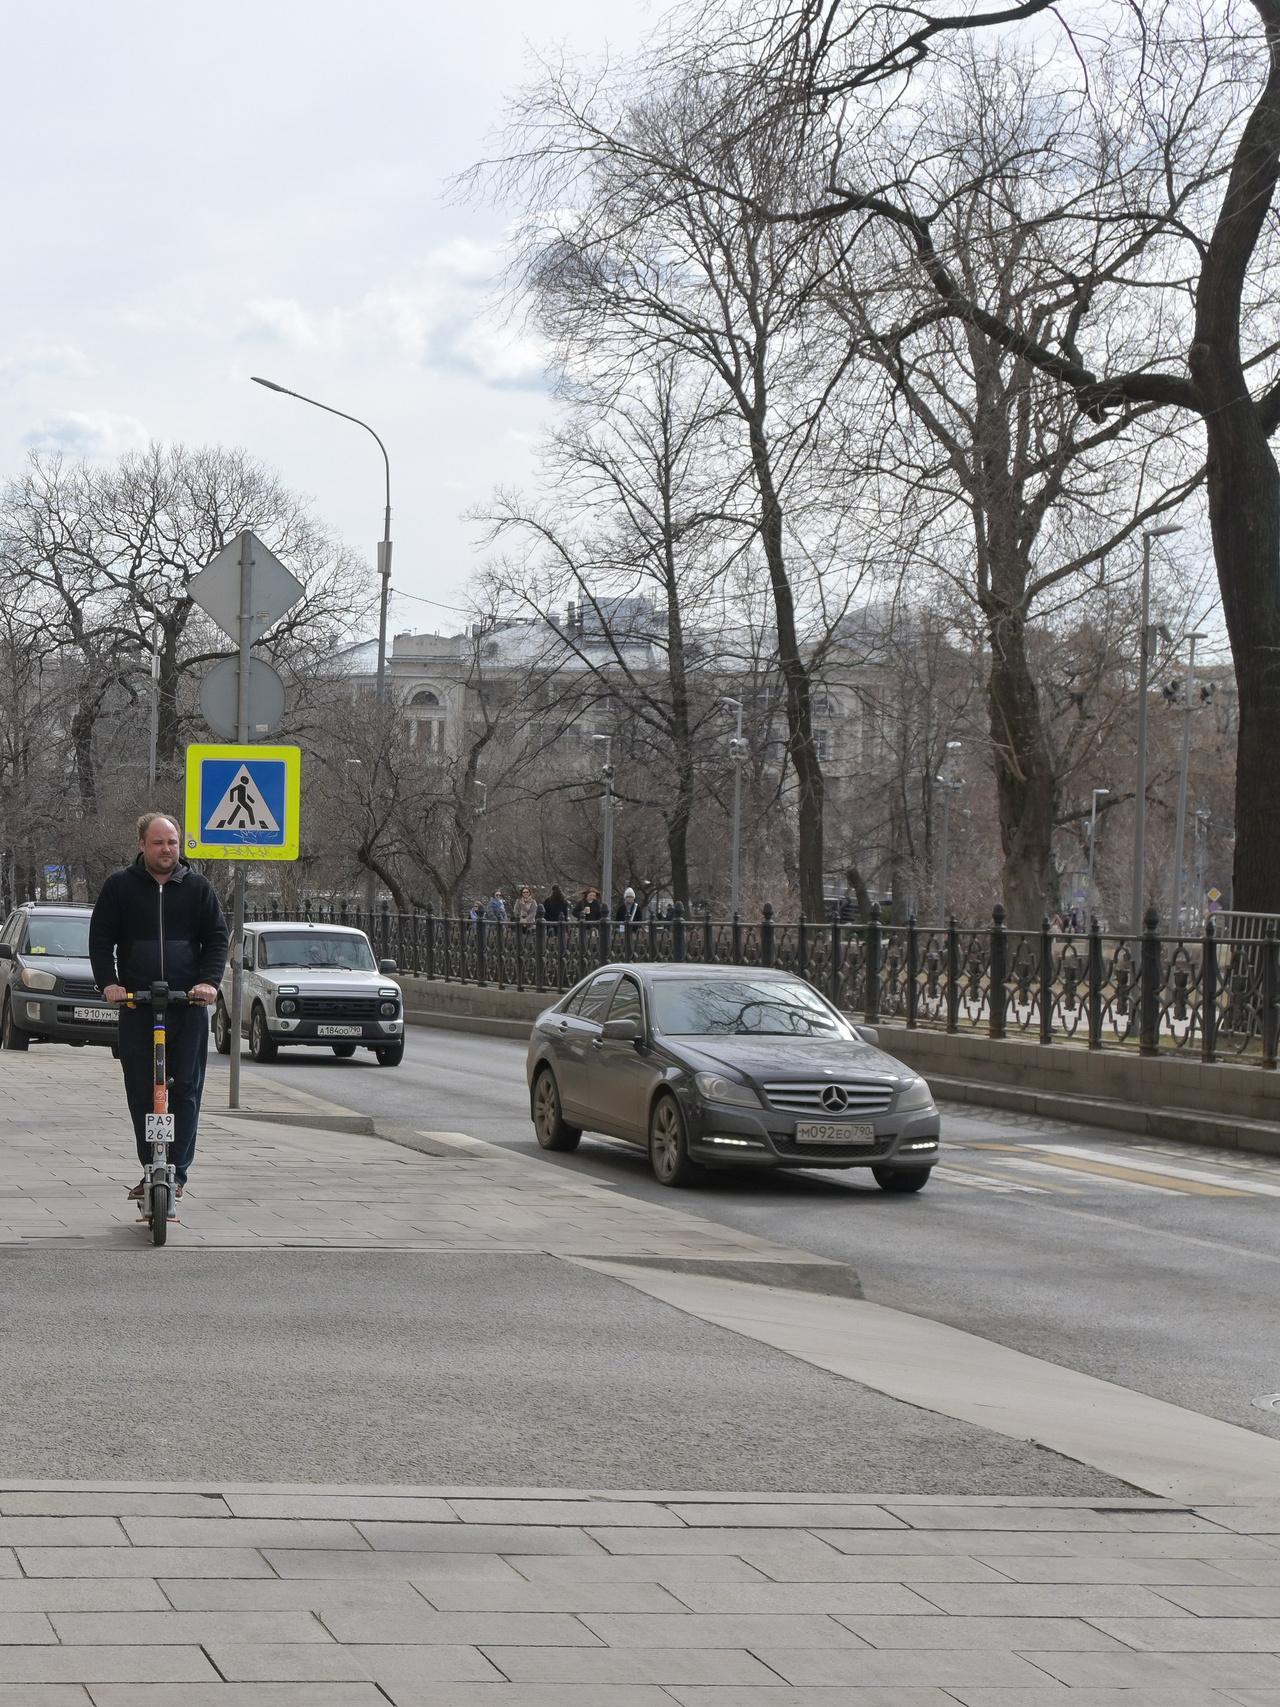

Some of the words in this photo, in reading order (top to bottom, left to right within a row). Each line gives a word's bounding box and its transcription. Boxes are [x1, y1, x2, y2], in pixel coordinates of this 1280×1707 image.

[147, 1129, 172, 1140] 264
[801, 1125, 852, 1139] М092ЕО
[853, 1126, 871, 1136] 790
